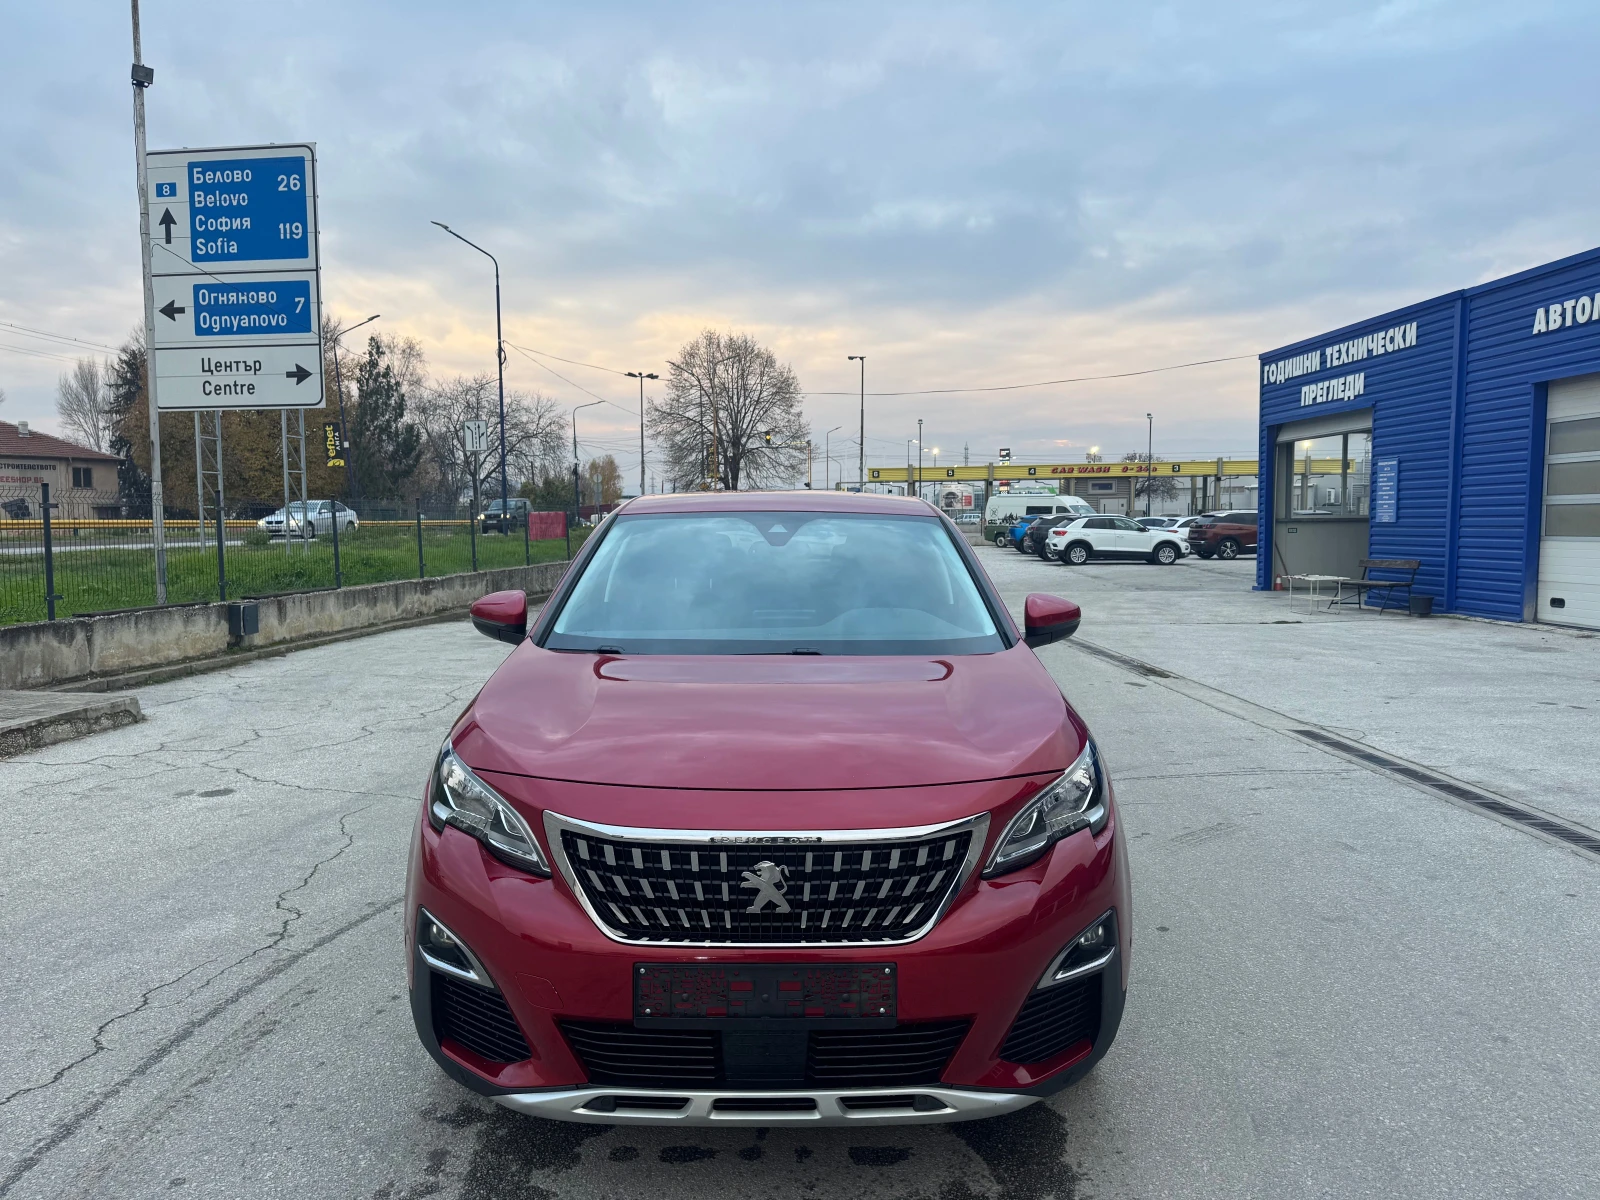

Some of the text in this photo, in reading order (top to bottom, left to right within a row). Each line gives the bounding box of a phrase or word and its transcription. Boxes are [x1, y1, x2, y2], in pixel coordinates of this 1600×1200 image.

[193, 168, 252, 184] Белово
[277, 174, 301, 191] 26
[162, 184, 170, 196] 8
[194, 190, 249, 208] Belovo
[195, 215, 251, 232] София
[278, 222, 303, 240] 119
[196, 238, 238, 255] Sofia
[198, 289, 277, 306] Огняново
[294, 297, 305, 314] 7
[199, 312, 288, 332] Ognyanovo
[1263, 322, 1418, 385] ГОДИШНИ ТЕХНИЧЕСКИ
[201, 357, 262, 376] Център
[202, 380, 256, 396] Centre
[1300, 373, 1365, 407] ПРЕГЛЕДИ
[325, 424, 336, 457] efbet
[1051, 466, 1075, 474] CAR
[1077, 466, 1111, 474] WASH
